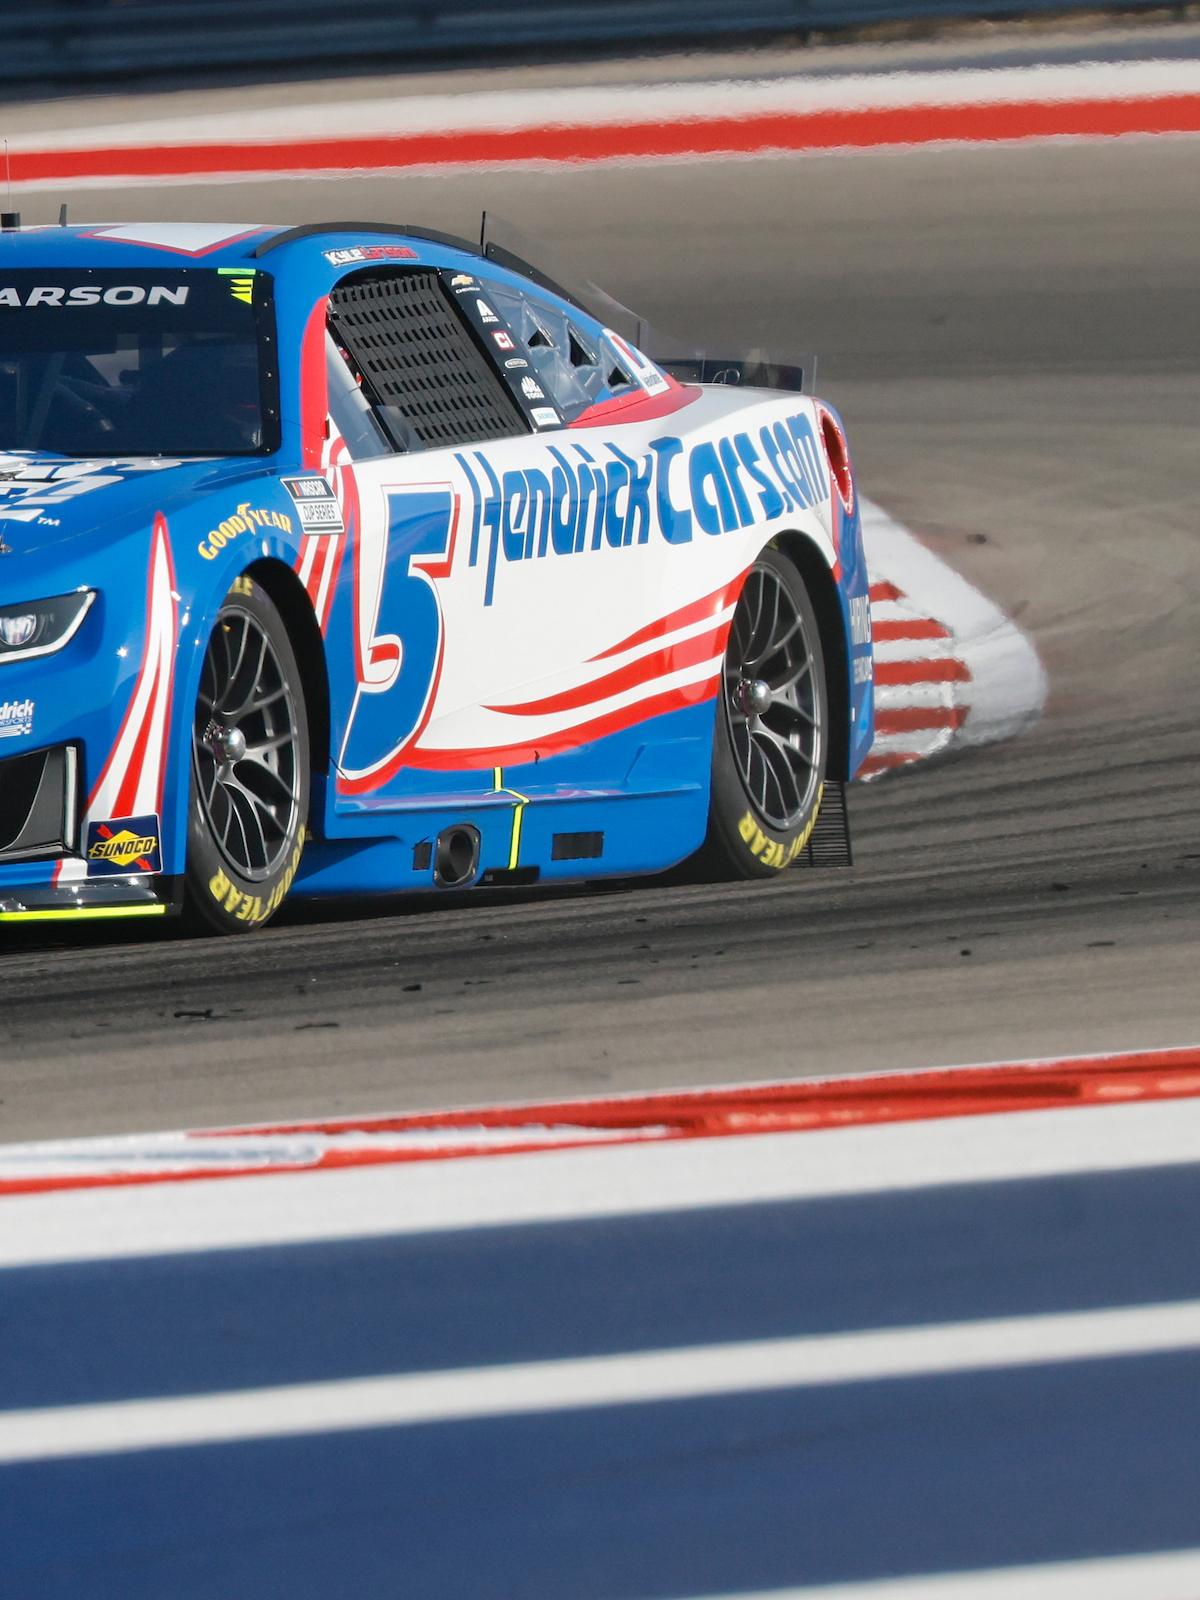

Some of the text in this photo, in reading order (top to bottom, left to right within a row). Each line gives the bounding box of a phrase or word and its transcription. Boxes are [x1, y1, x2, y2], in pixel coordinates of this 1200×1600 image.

[198, 503, 293, 560] GOODYEAR
[303, 504, 336, 520] CUP SERIES
[454, 412, 830, 607] HendrickCars.com
[338, 482, 460, 781] 5
[91, 838, 153, 857] SUNOCO
